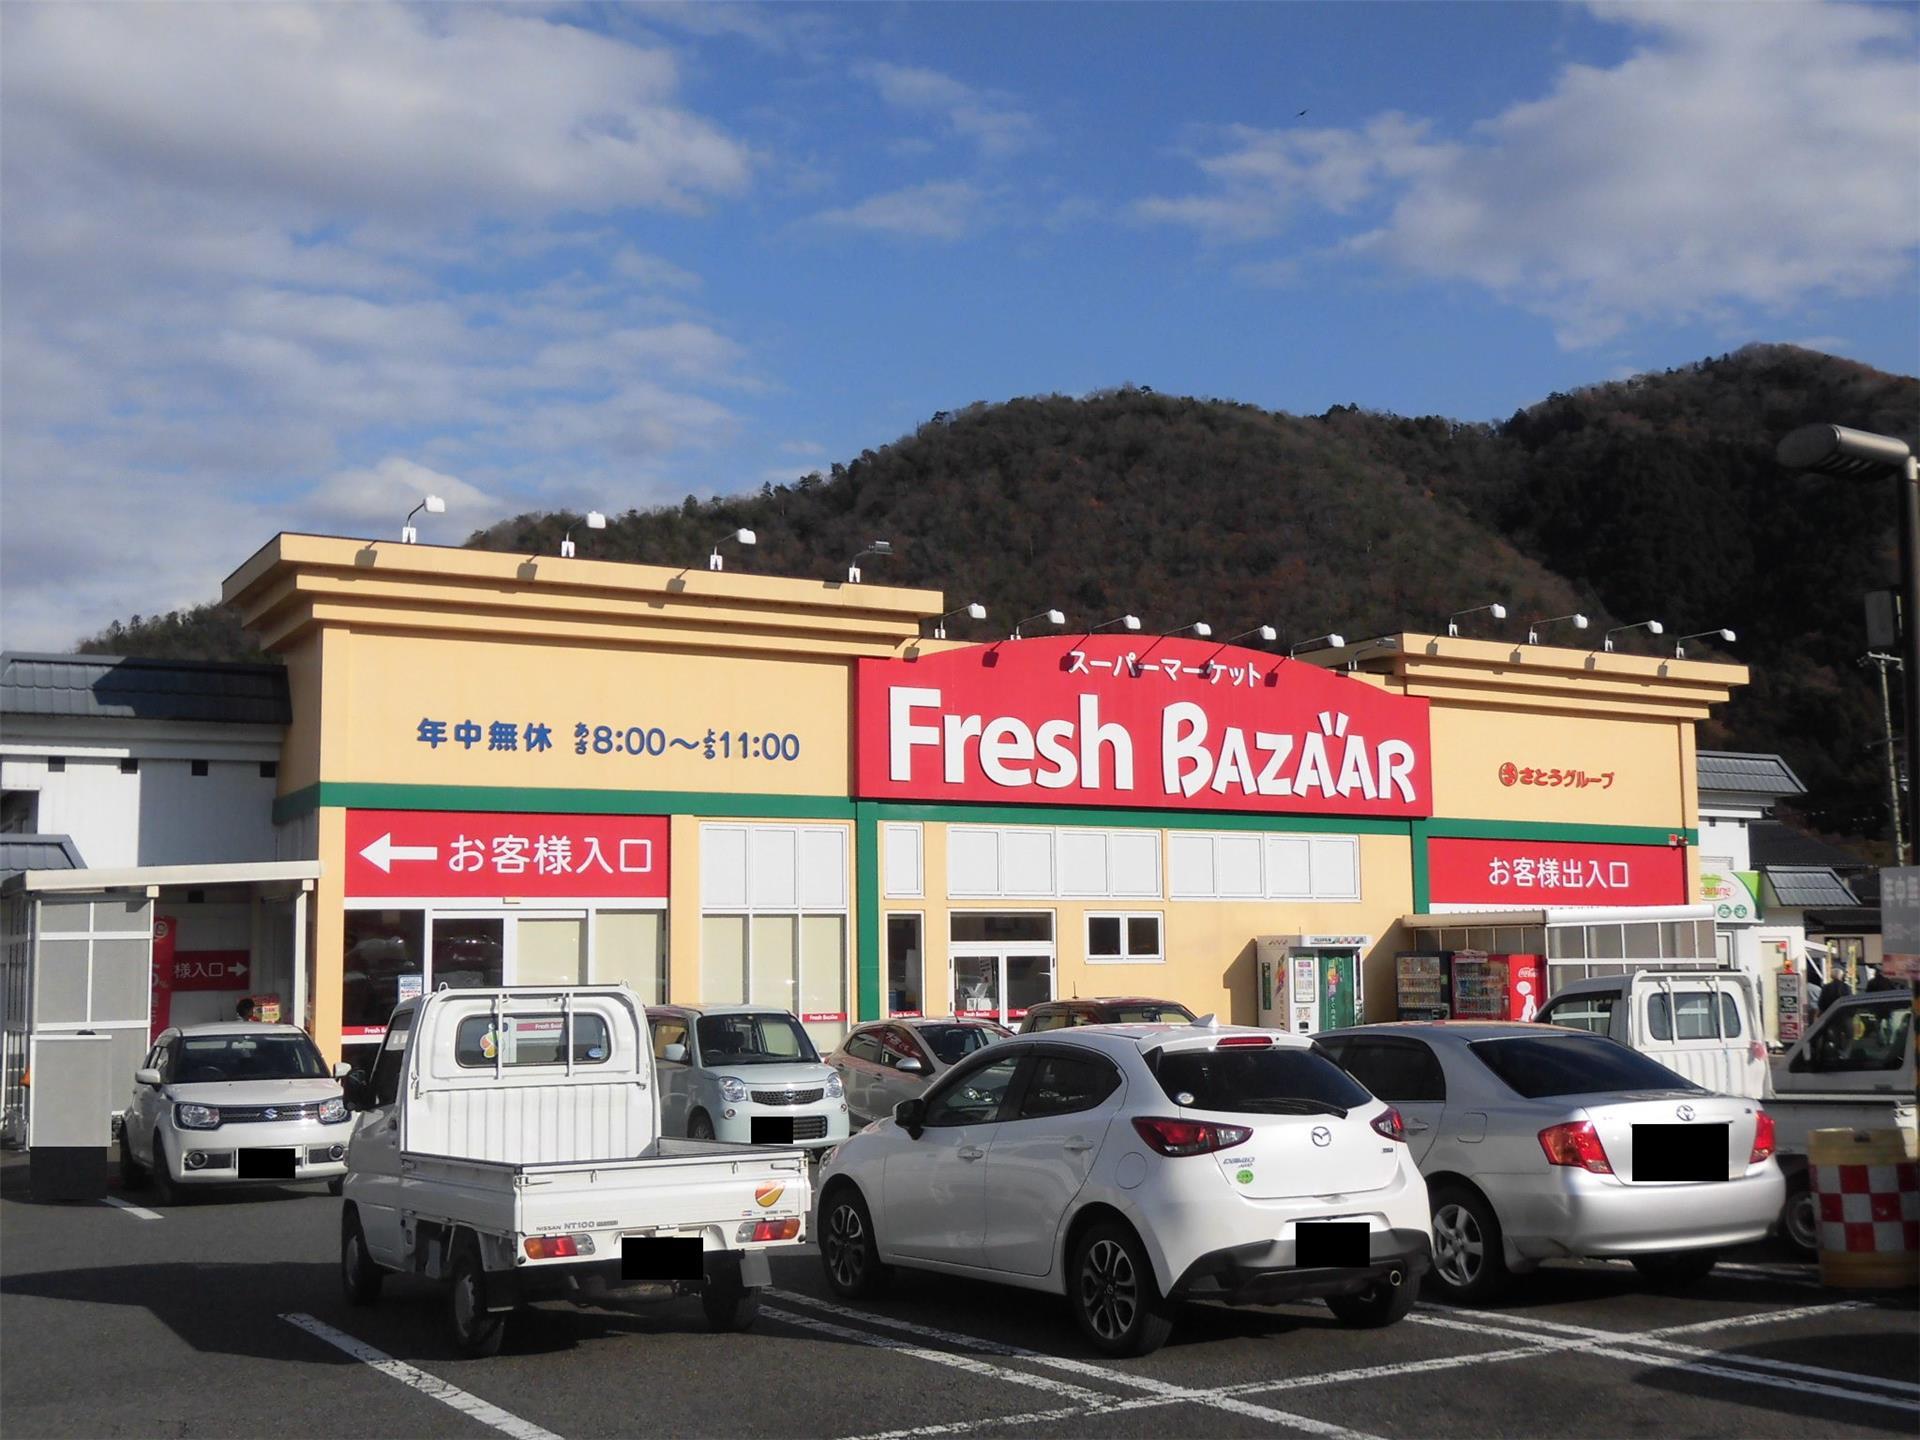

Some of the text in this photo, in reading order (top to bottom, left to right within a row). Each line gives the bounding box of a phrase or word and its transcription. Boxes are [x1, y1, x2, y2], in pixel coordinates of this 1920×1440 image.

[1069, 651, 1262, 688] スーパーマーケット
[416, 717, 553, 752] 年中無休
[889, 686, 1134, 790] Fresh
[1519, 767, 1615, 789] さとうグループ
[448, 833, 653, 875] お客様入口
[1488, 857, 1630, 888] お客様出入口
[173, 961, 224, 979] 様入口
